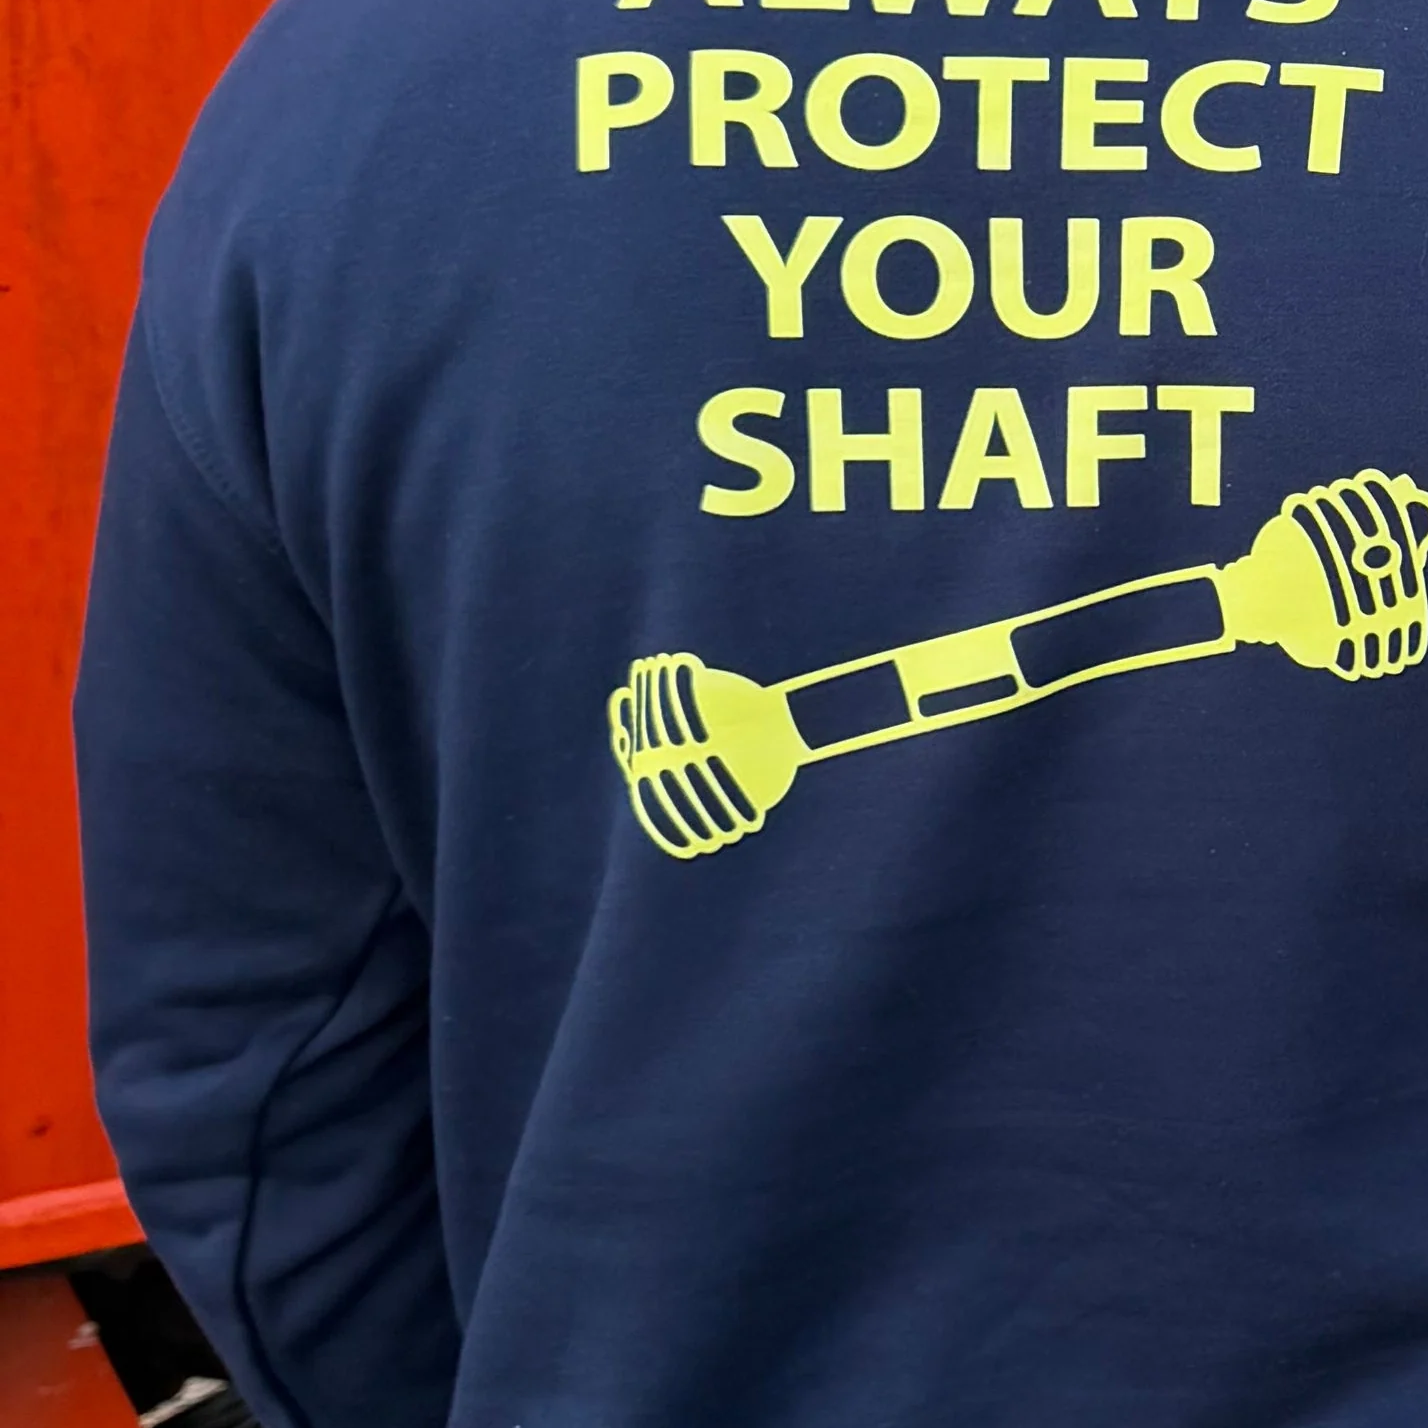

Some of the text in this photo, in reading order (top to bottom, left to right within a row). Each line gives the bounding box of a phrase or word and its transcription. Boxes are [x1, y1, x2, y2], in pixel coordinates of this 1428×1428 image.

[575, 49, 1385, 174] PROTECT
[721, 215, 1217, 340] YOUR
[696, 385, 1255, 517] SHAFT
